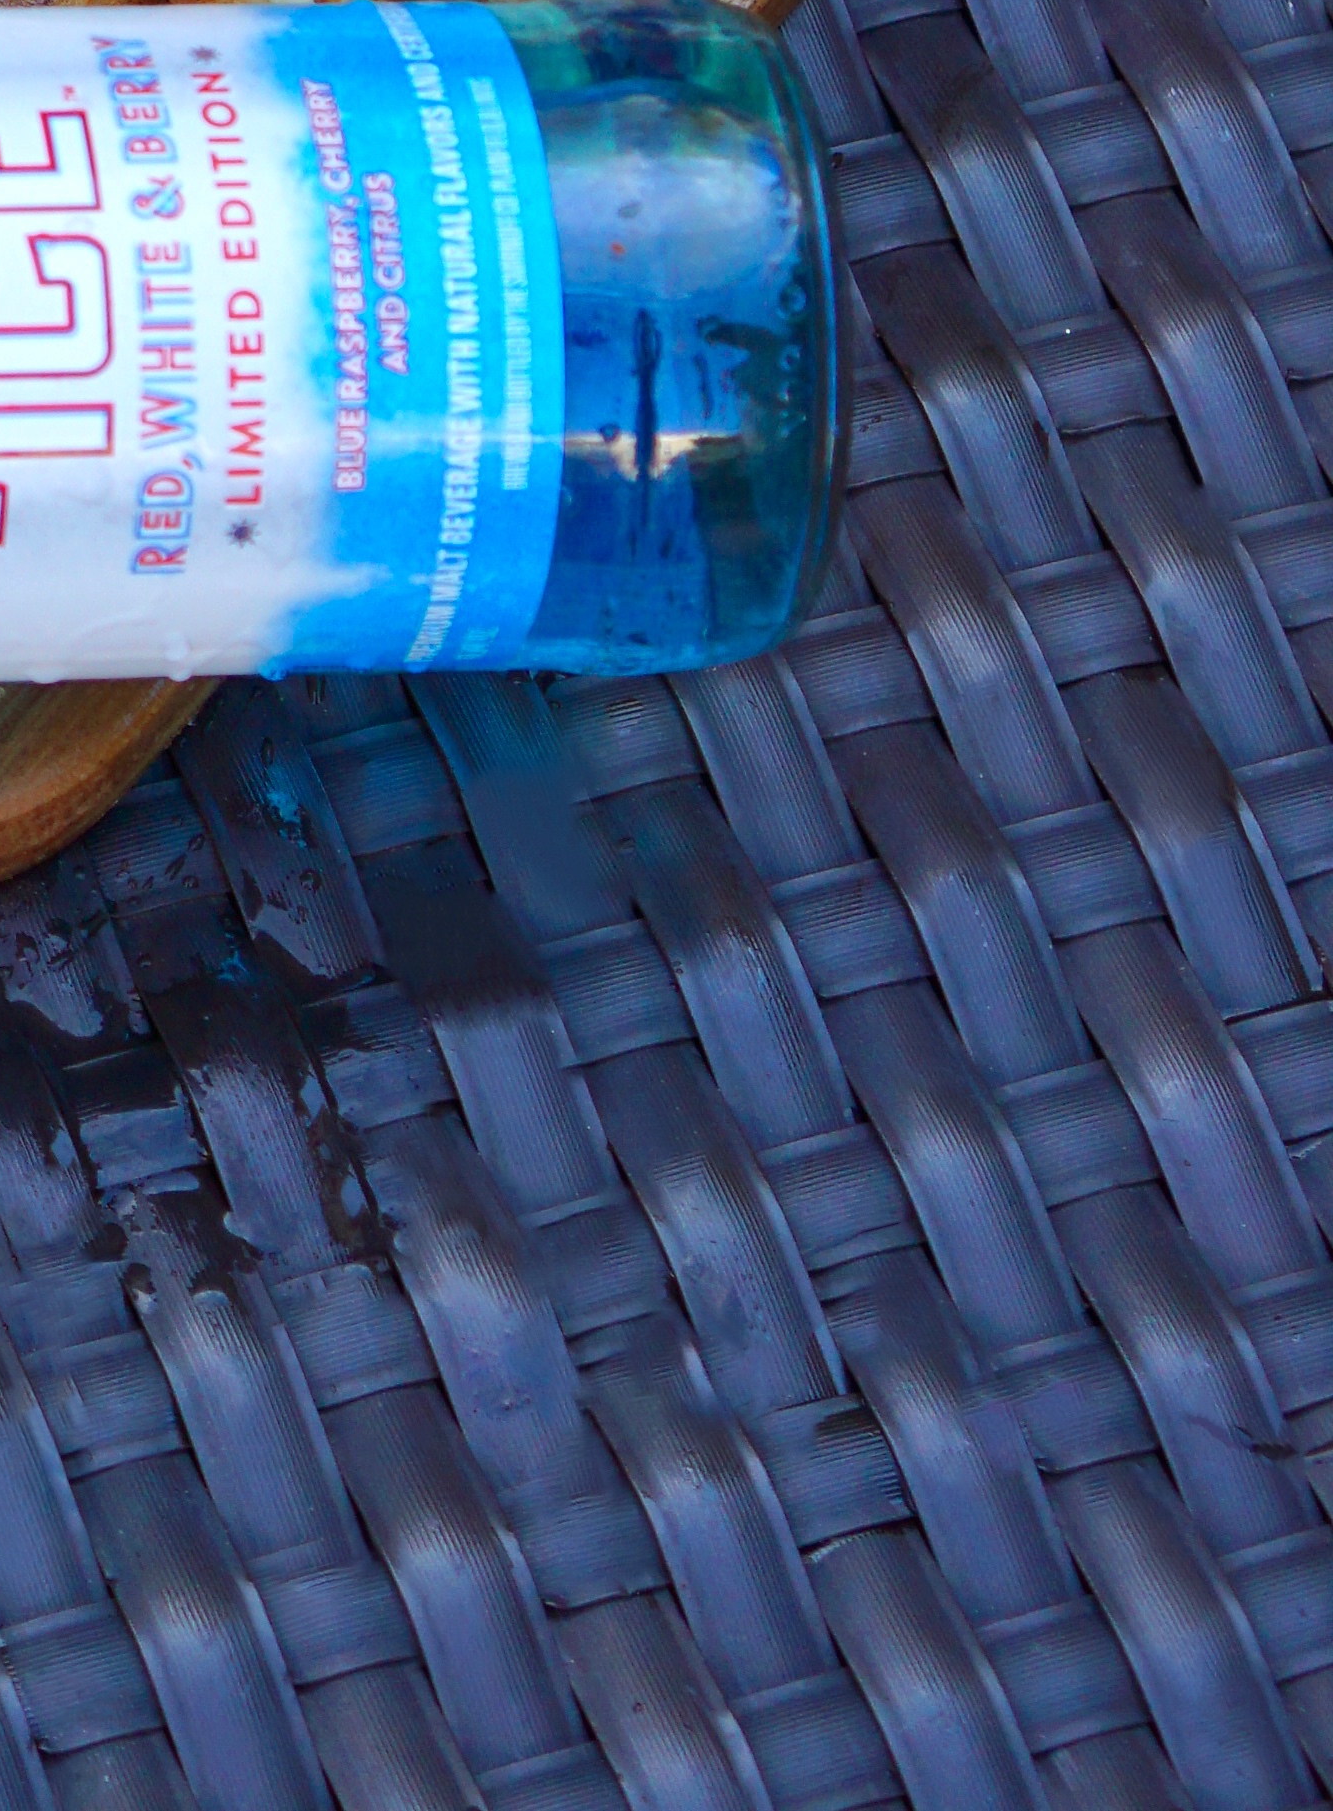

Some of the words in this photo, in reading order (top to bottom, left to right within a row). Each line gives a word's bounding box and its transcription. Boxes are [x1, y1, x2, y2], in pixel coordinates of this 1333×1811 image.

[91, 36, 178, 163] BERRY
[299, 78, 352, 191] CHERRY
[419, 104, 469, 207] FLAVORS
[131, 175, 184, 219] &
[190, 72, 260, 262] EDITION
[362, 172, 405, 290] CITRUS
[437, 209, 480, 335] NATURAL
[137, 242, 197, 450] WHITE
[324, 194, 368, 401] RASPBERRY,
[374, 294, 410, 375] AND
[225, 289, 264, 506] LIMITED
[447, 338, 482, 413] WITH
[130, 450, 204, 574] RED,
[335, 407, 368, 493] BLUE
[439, 415, 482, 545] BEVERAGE
